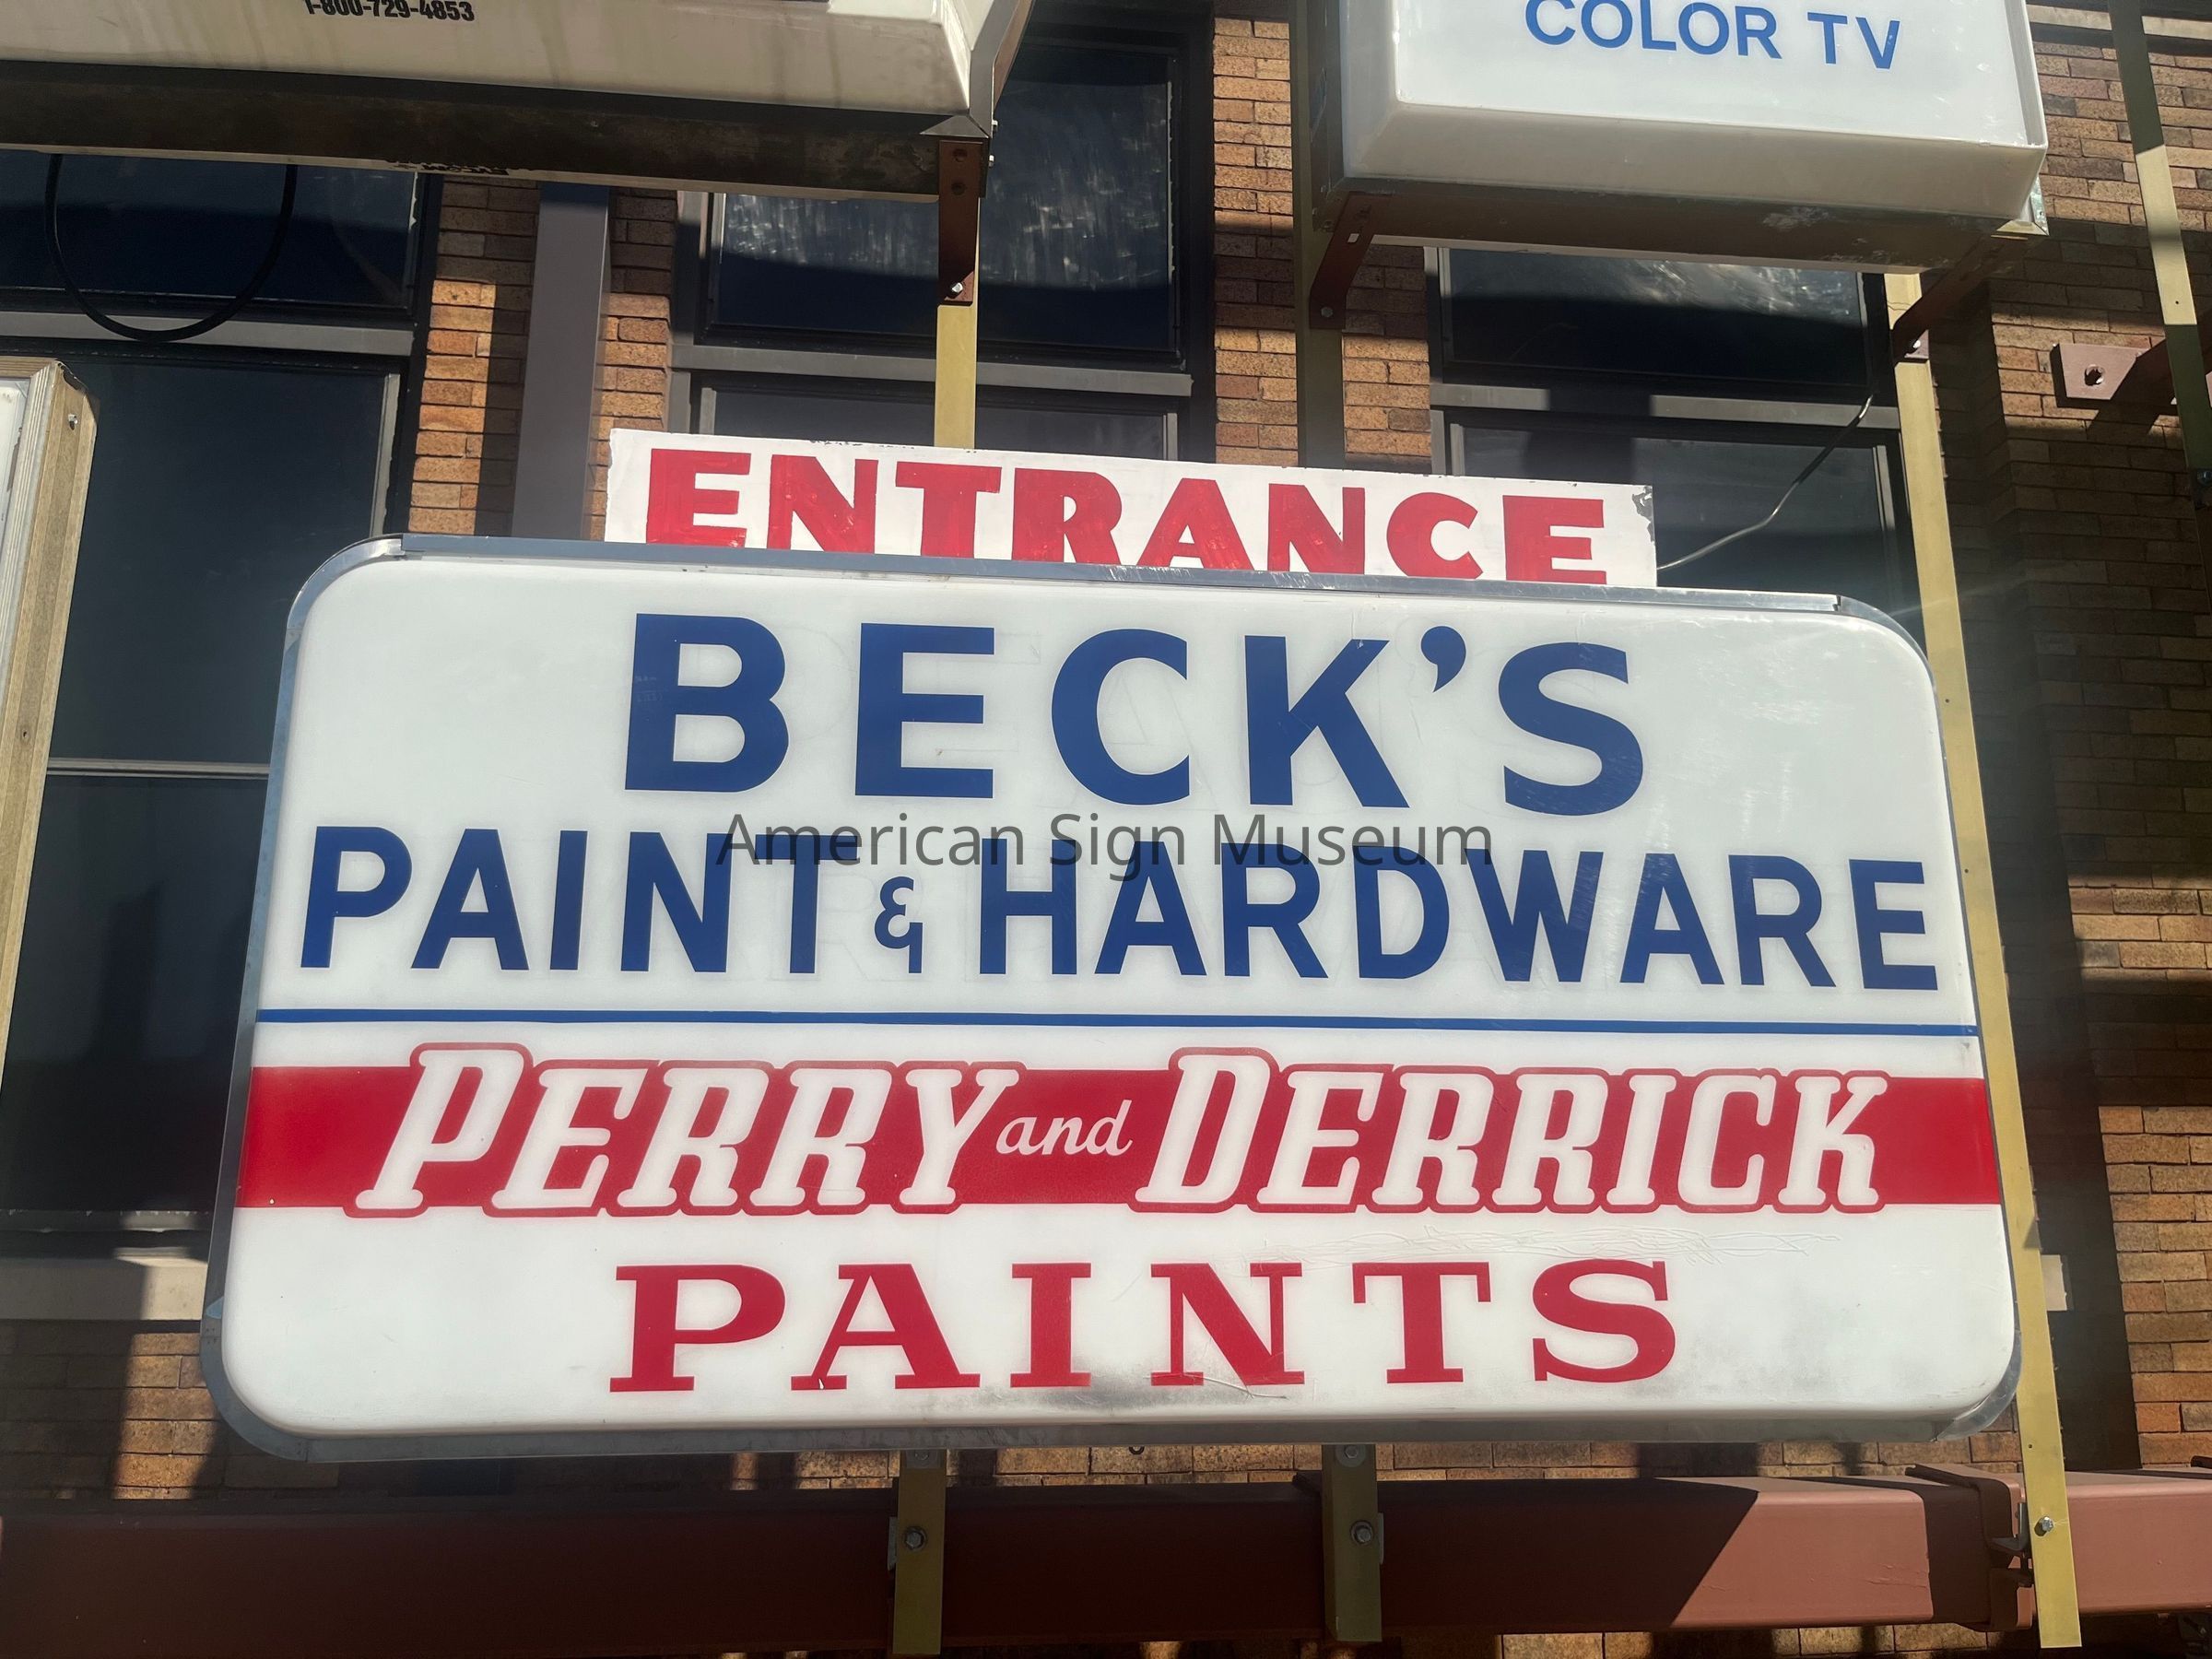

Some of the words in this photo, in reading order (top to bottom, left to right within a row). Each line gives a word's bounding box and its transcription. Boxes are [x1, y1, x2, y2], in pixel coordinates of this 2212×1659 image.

[304, 0, 475, 21] 1-800-729-4853
[1525, 0, 1782, 60] COLOR
[1806, 12, 1900, 70] TV
[646, 448, 1606, 585] ENTRANCE
[625, 613, 1645, 816] BECK'S
[300, 826, 858, 973] PAINT
[875, 876, 923, 973] &
[979, 838, 1938, 990] HARDWARE
[354, 1048, 1021, 1211] PERRY
[995, 1100, 1133, 1158] and
[1135, 1053, 1888, 1209] DERRICK
[610, 1258, 1675, 1393] PAINTS
